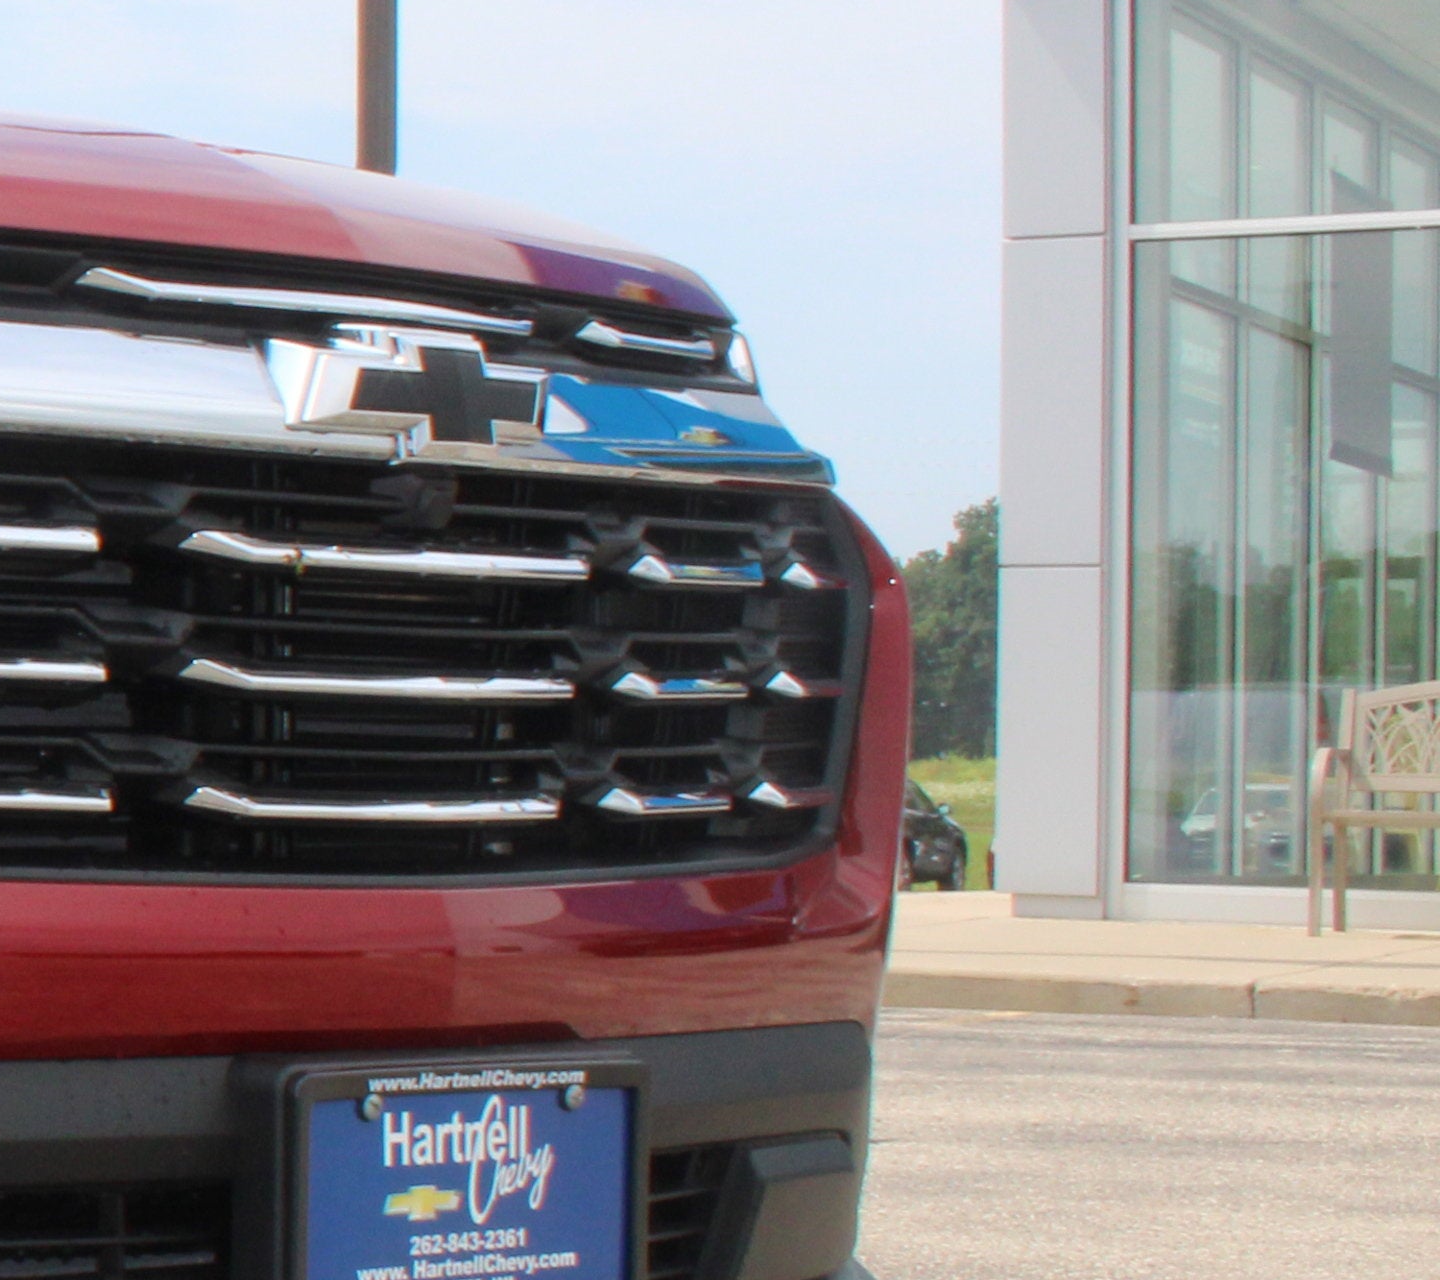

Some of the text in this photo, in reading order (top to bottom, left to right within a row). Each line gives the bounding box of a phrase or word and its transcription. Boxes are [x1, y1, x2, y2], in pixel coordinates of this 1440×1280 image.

[367, 1070, 586, 1092] www.HartnellChevy.com
[383, 1105, 529, 1168] Hartnell
[468, 1094, 555, 1224] Chevy
[409, 1228, 528, 1256] 262-843-2361
